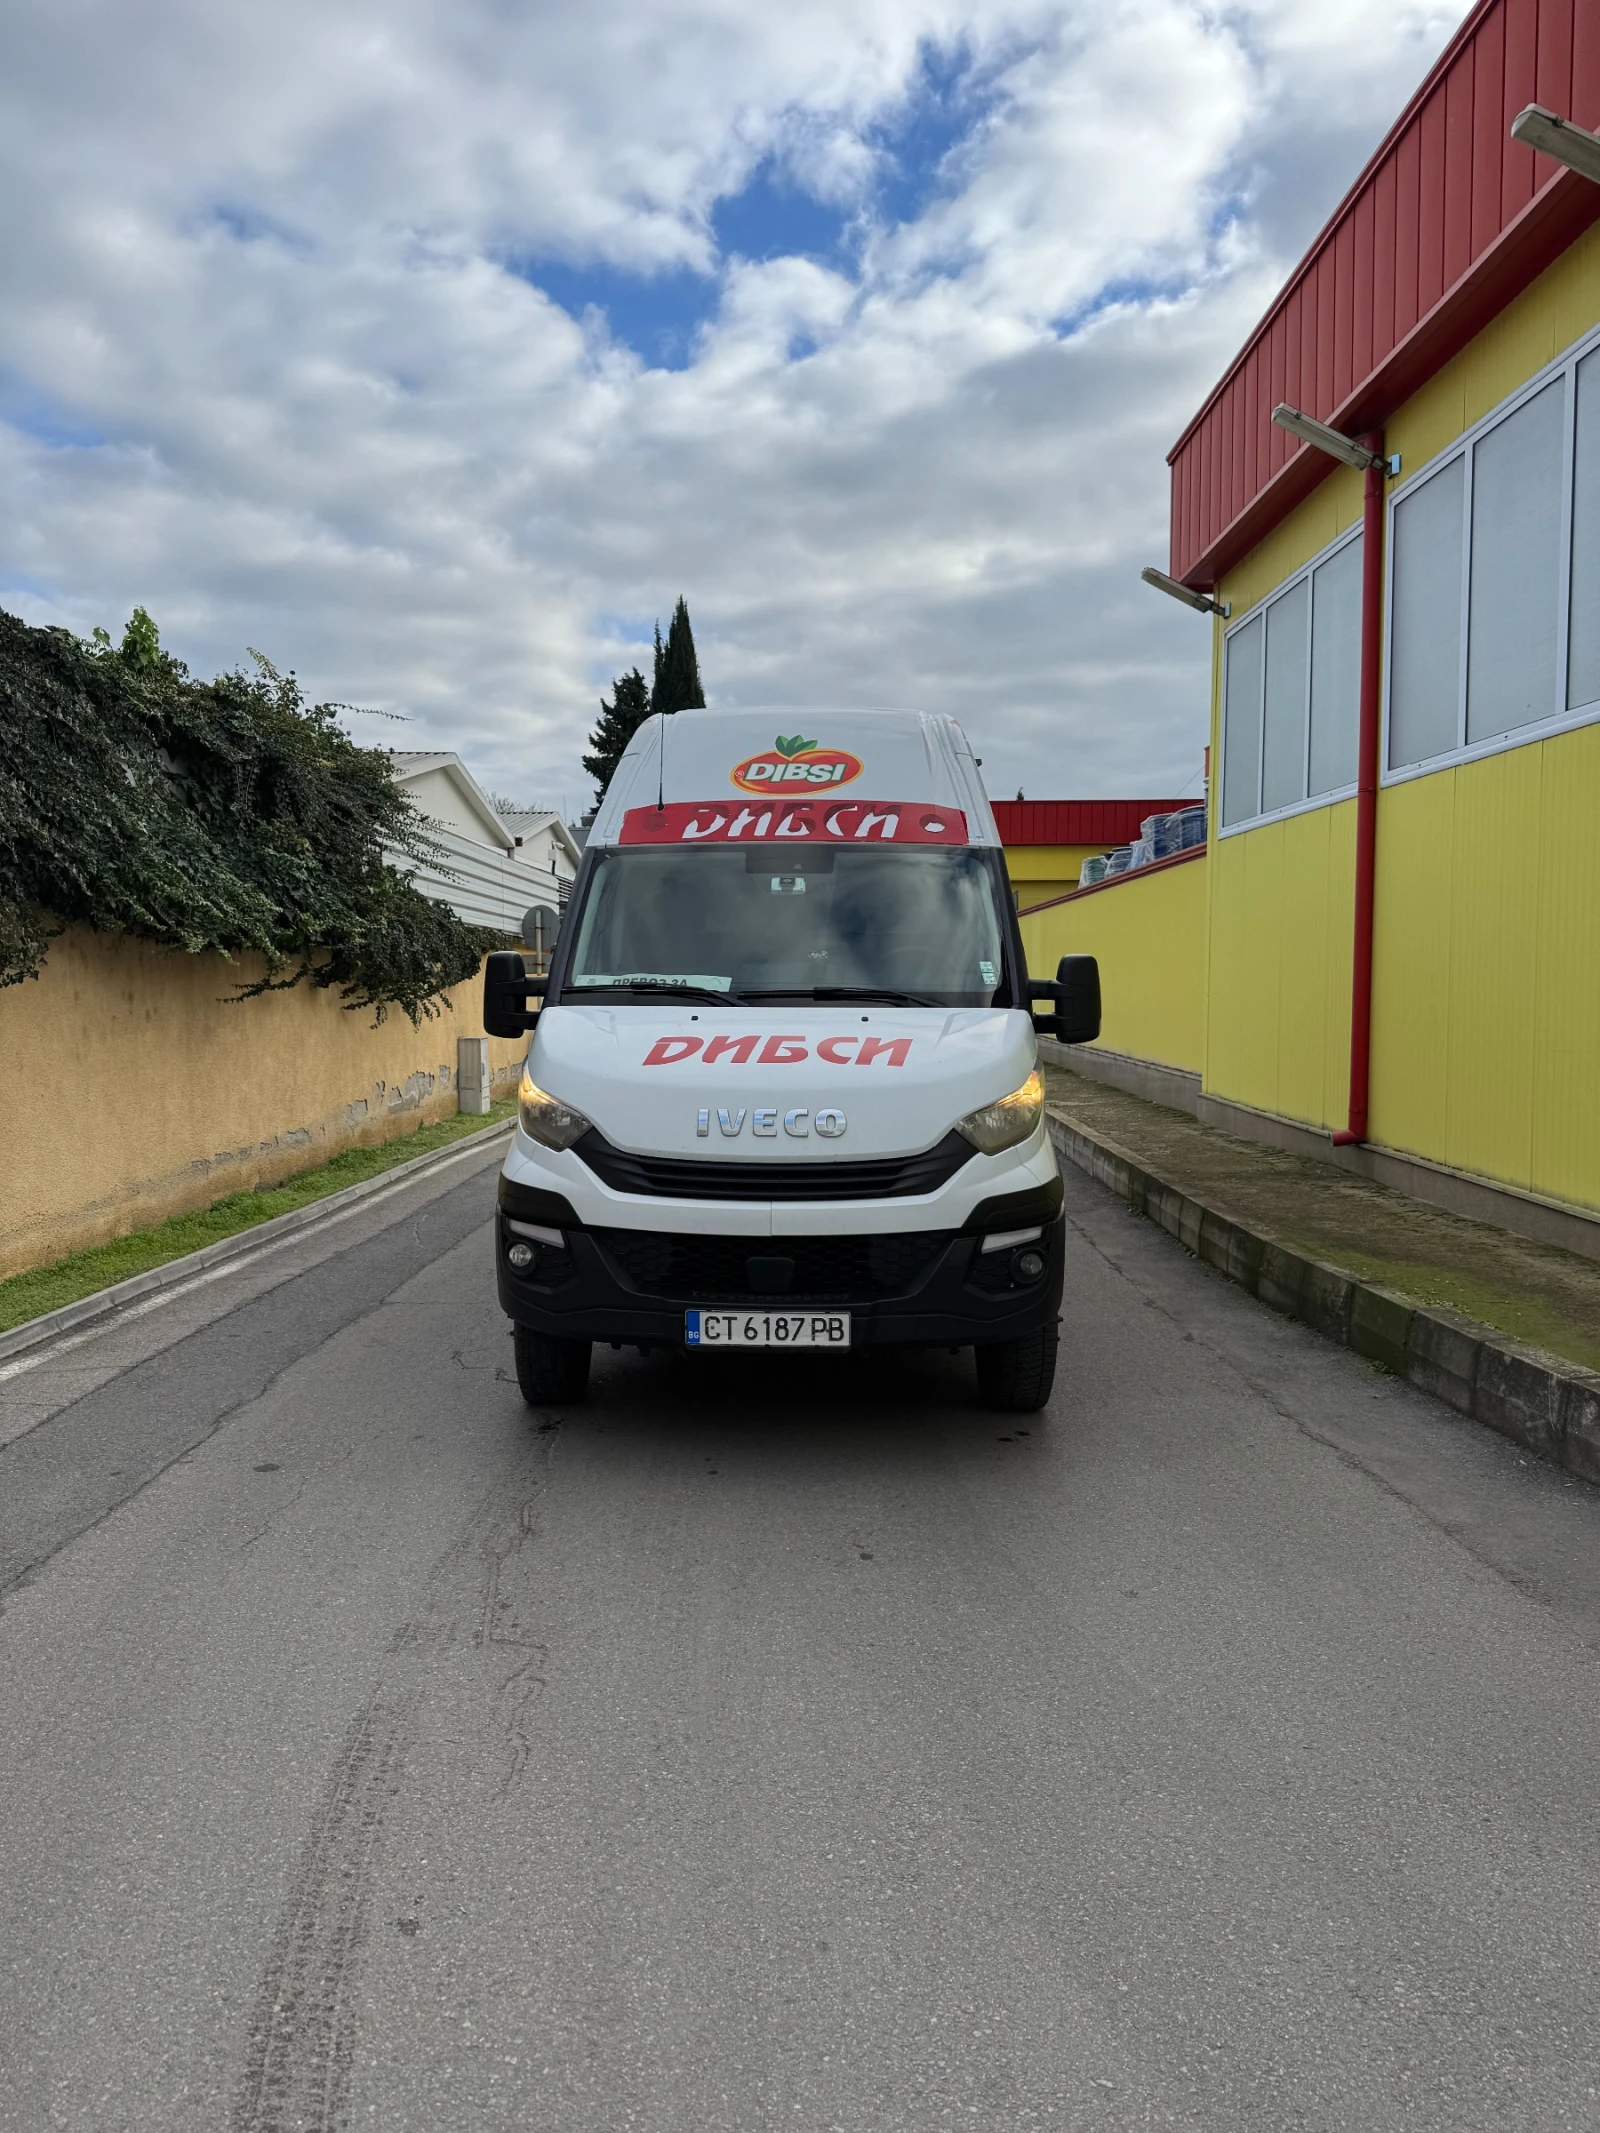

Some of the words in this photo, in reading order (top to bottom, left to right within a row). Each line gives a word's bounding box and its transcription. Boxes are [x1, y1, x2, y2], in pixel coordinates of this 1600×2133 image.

[743, 762, 848, 784] DIBSI
[696, 1108, 848, 1138] IVECO
[688, 1331, 699, 1339] BG
[743, 1316, 806, 1341] 6187
